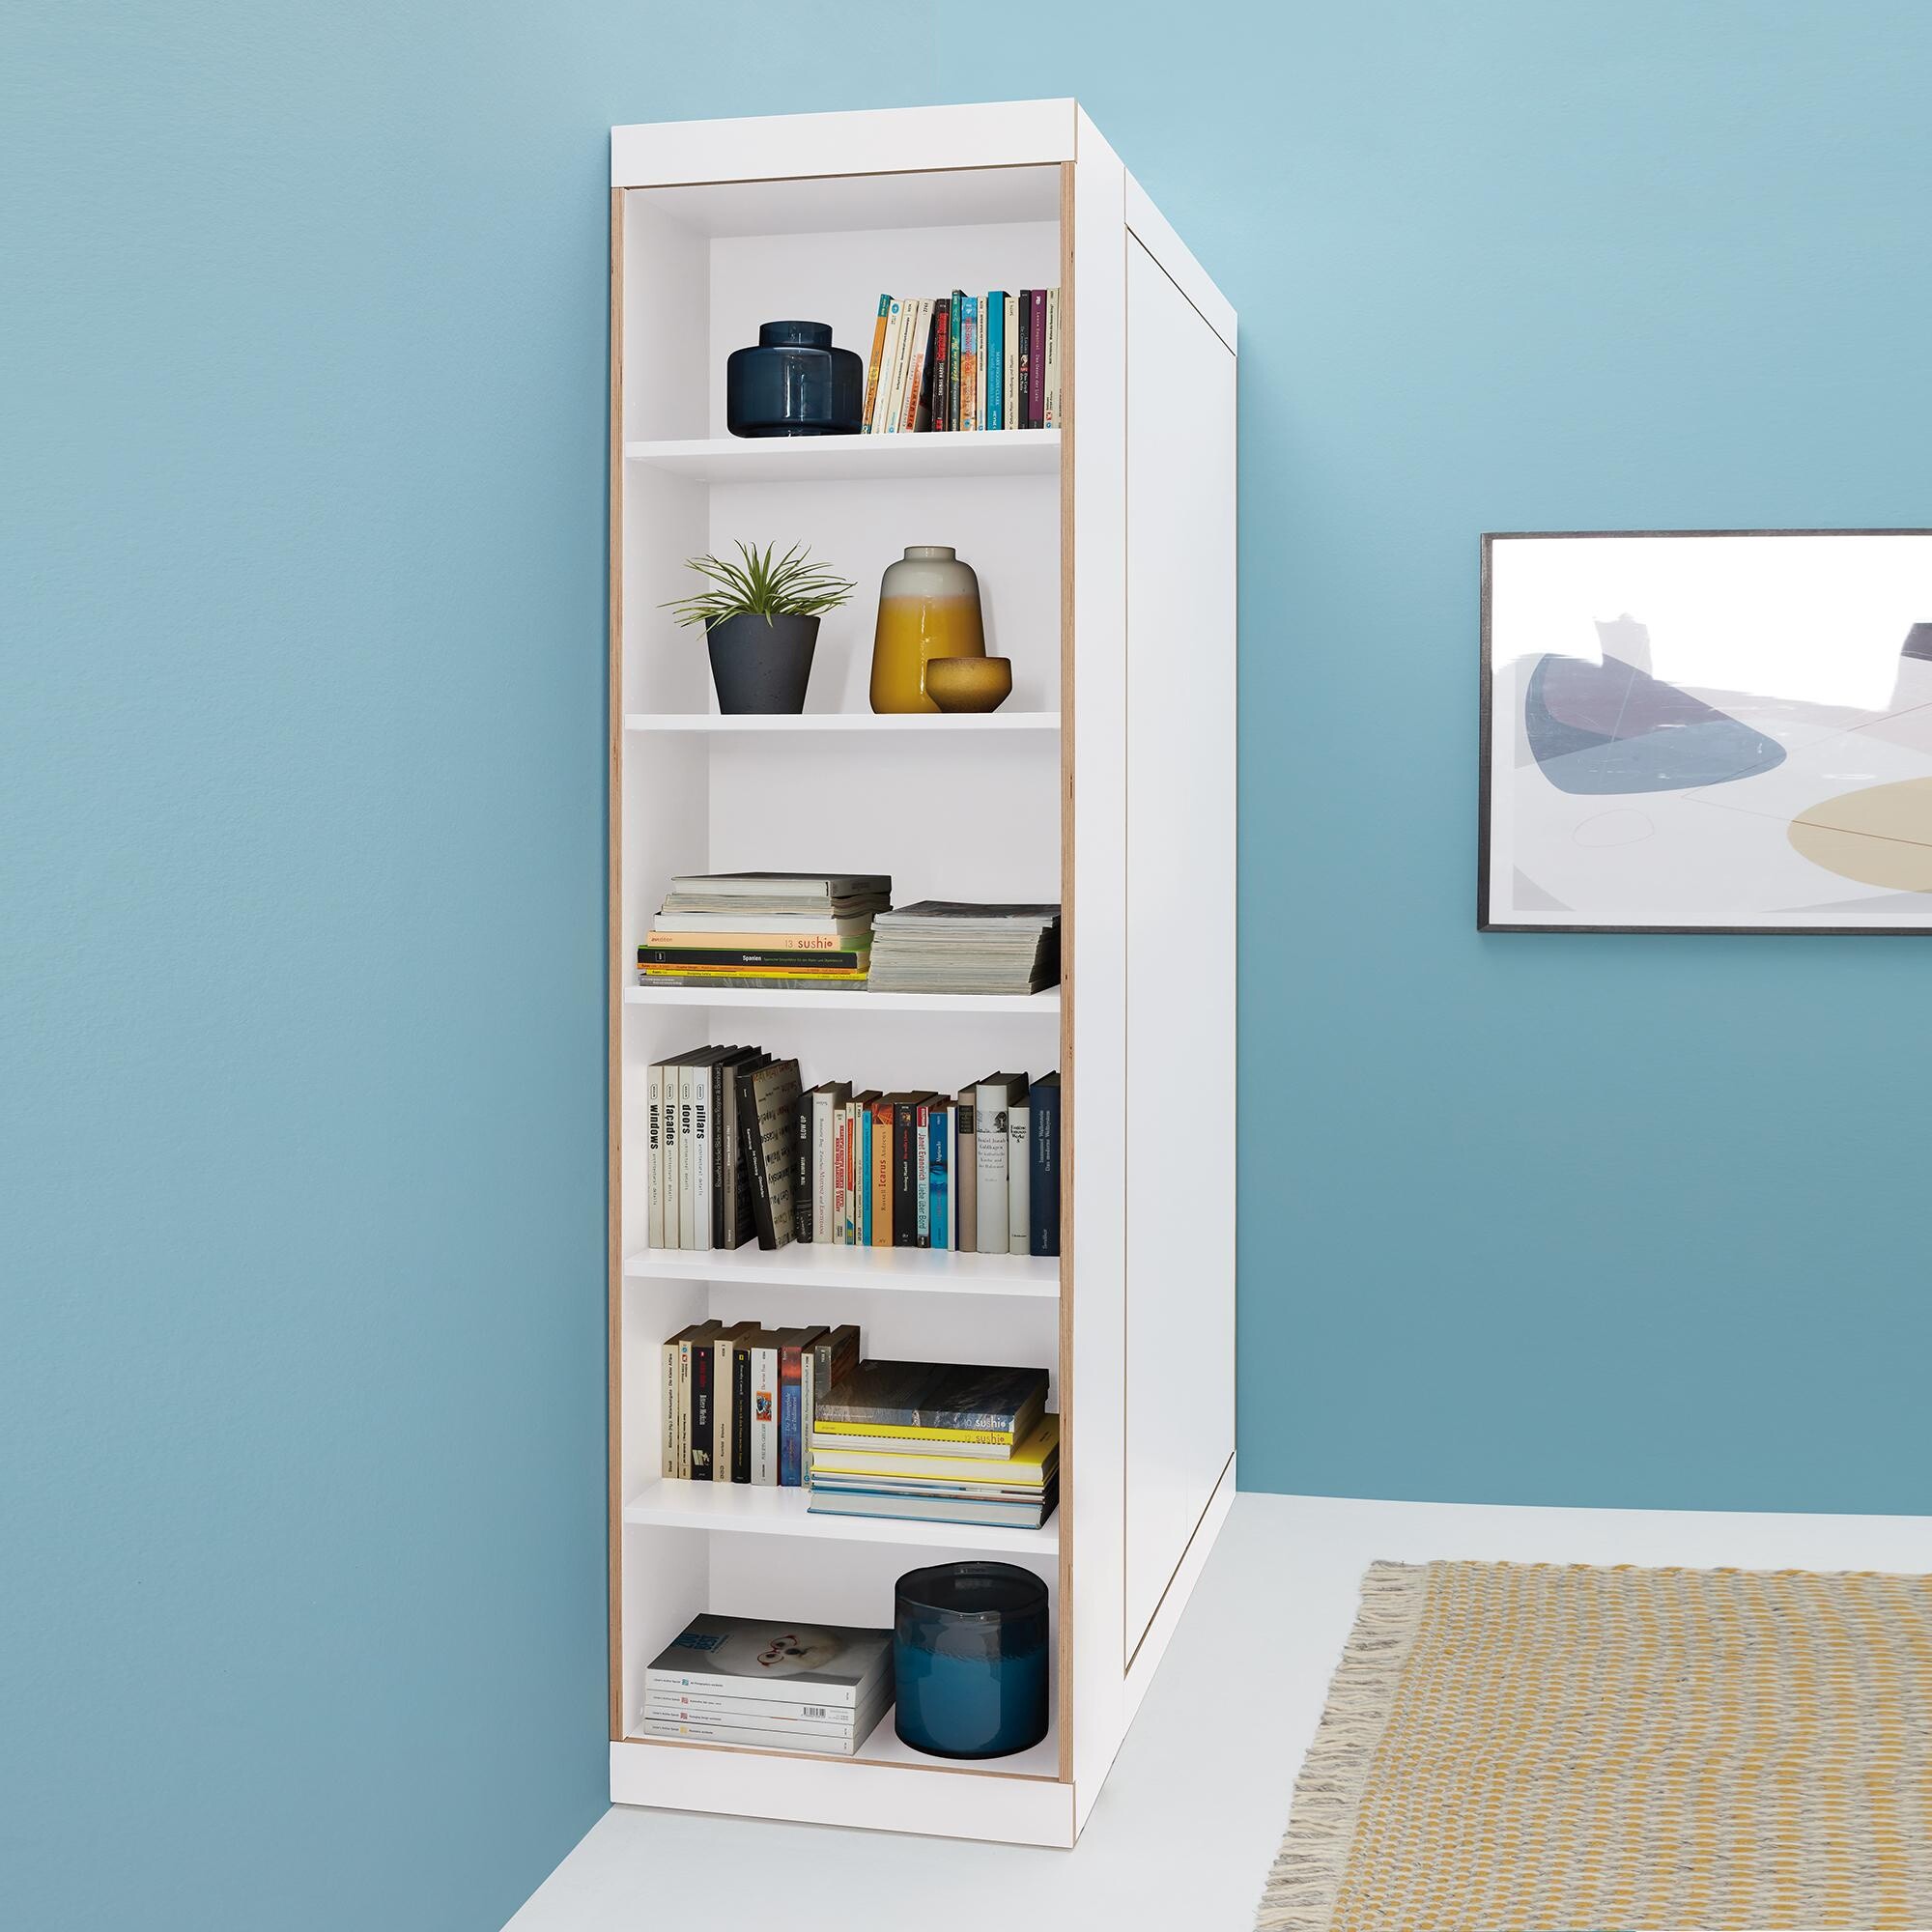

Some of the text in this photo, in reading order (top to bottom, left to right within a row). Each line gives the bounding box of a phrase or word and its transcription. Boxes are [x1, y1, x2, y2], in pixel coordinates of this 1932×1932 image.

[650, 1104, 660, 1150] windows
[665, 1104, 675, 1146] façades
[682, 1104, 691, 1134] doors
[696, 1104, 706, 1139] pillars
[918, 1133, 926, 1151] Janet
[878, 1160, 887, 1187] Icarus
